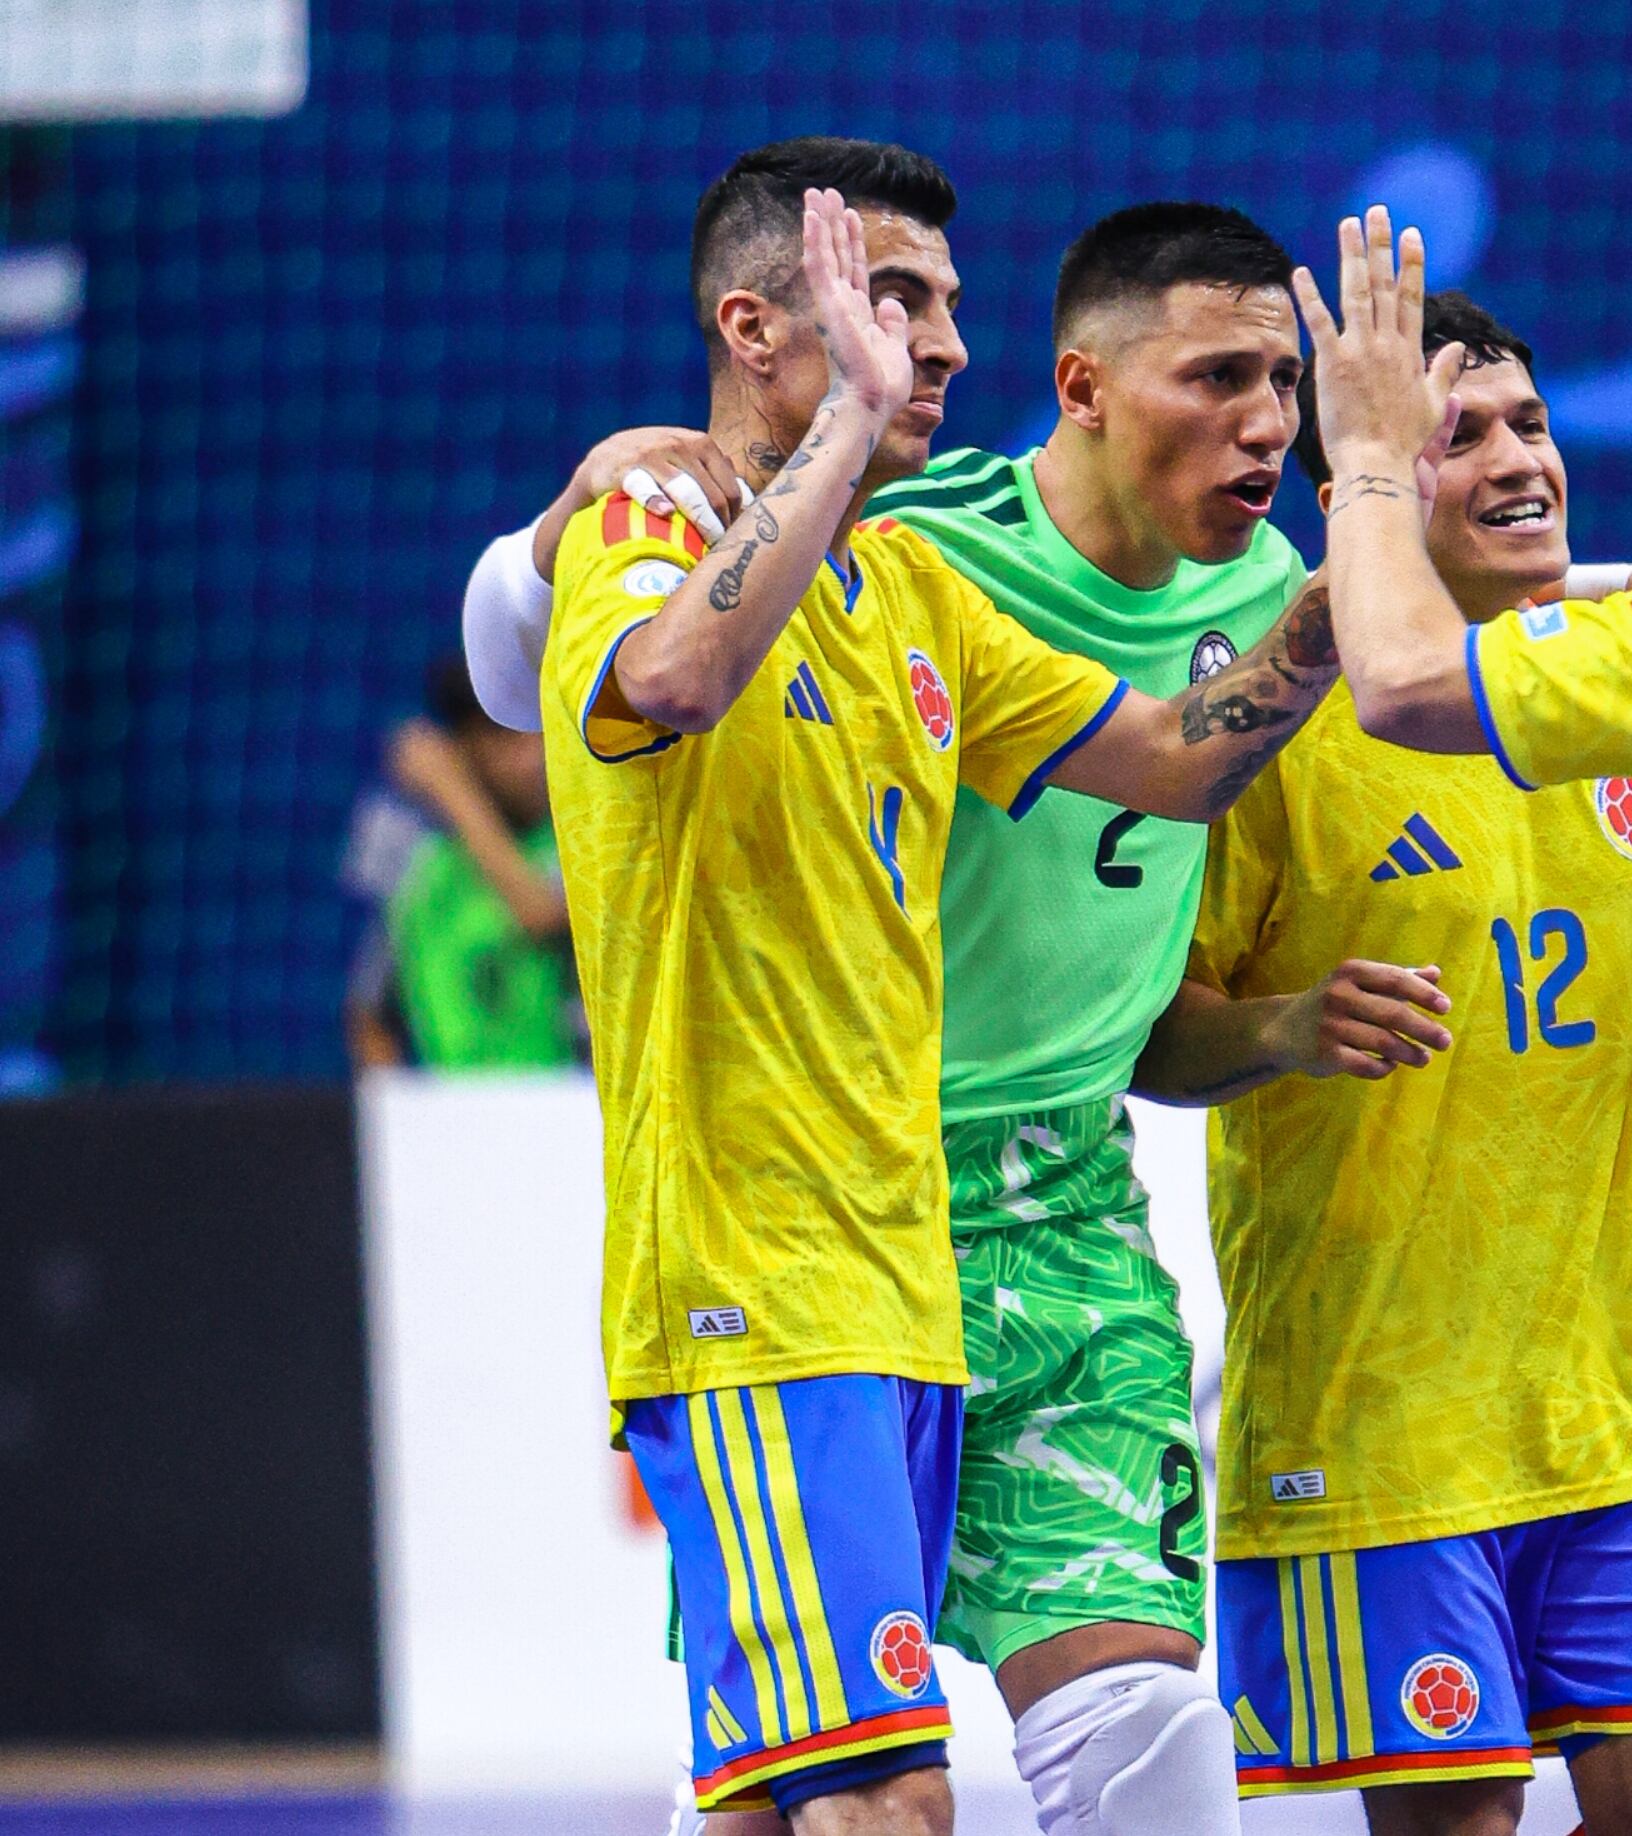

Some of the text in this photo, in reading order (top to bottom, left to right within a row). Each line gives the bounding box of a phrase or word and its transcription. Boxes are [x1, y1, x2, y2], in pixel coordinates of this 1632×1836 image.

[1094, 809, 1147, 889] 2
[1491, 908, 1596, 1055] 12
[1160, 1442, 1200, 1584] 2
